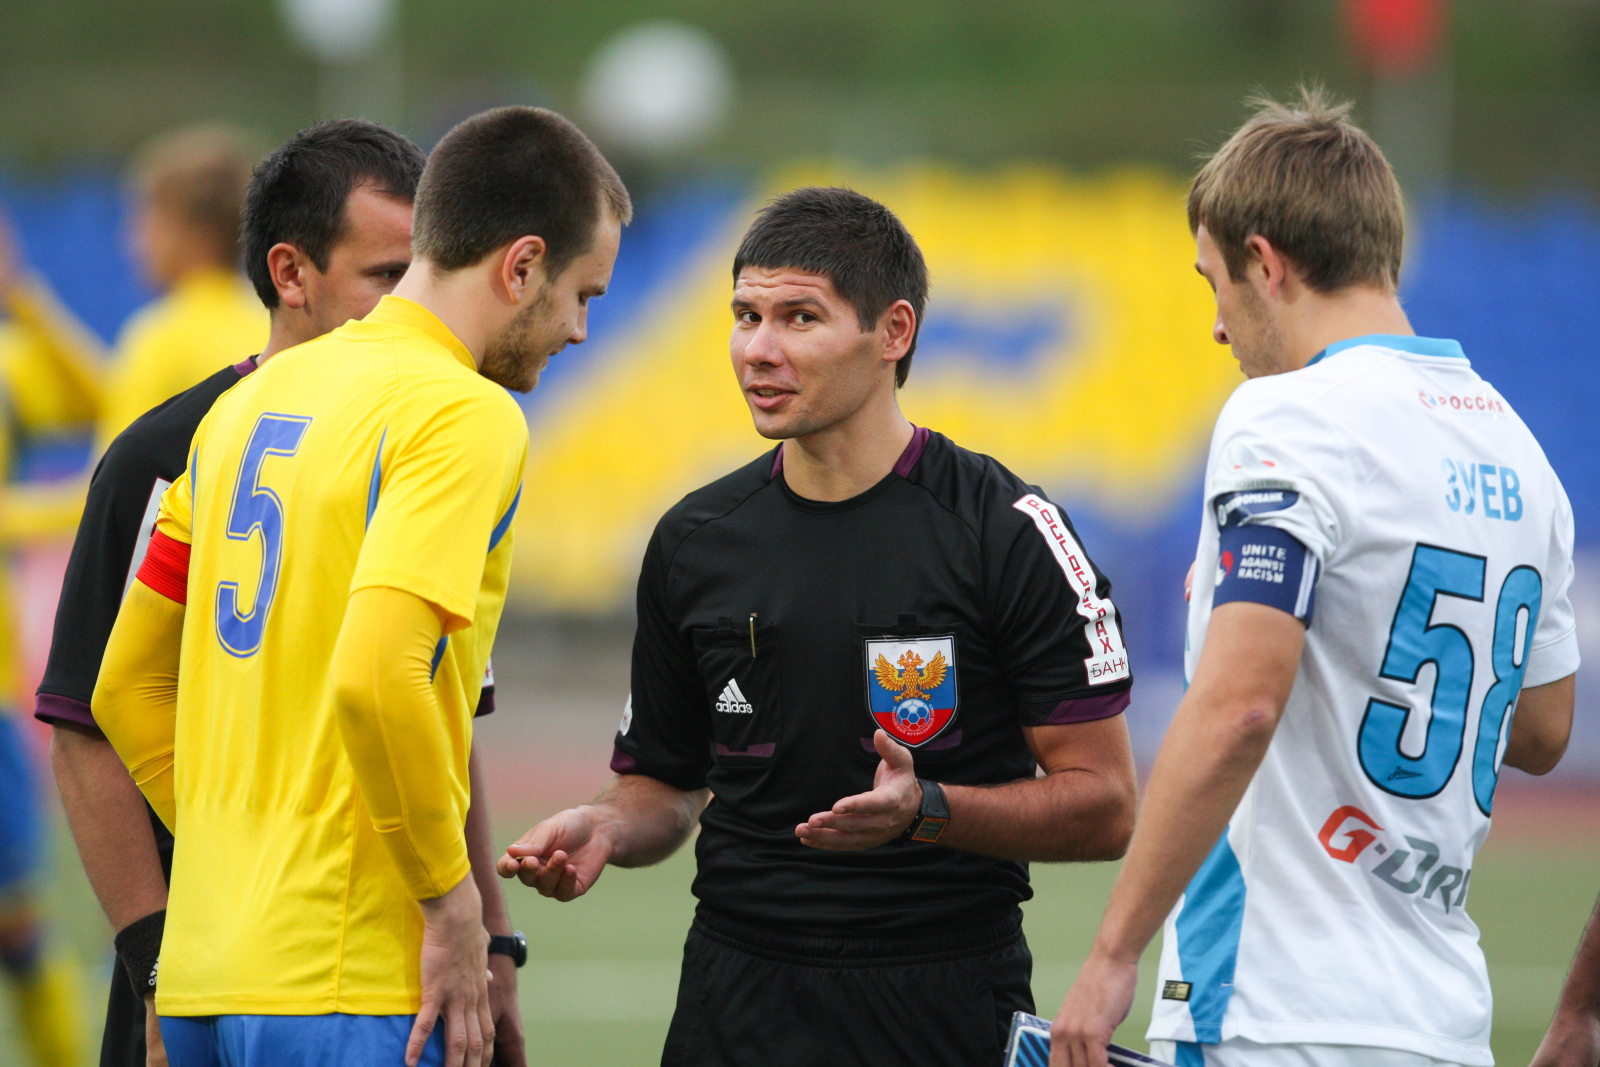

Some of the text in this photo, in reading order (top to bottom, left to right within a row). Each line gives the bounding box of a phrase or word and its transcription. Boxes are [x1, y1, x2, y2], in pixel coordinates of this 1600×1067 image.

[1437, 395, 1505, 414] РОССИЯ
[1441, 457, 1523, 522] ЗУЕВ
[214, 411, 313, 659] 5
[1241, 544, 1286, 560] UNITE
[1239, 557, 1285, 573] AGAINST
[1237, 568, 1284, 584] RACISM
[1357, 541, 1543, 818] 58
[715, 701, 753, 714] adidas
[1317, 804, 1471, 915] G-DRI
